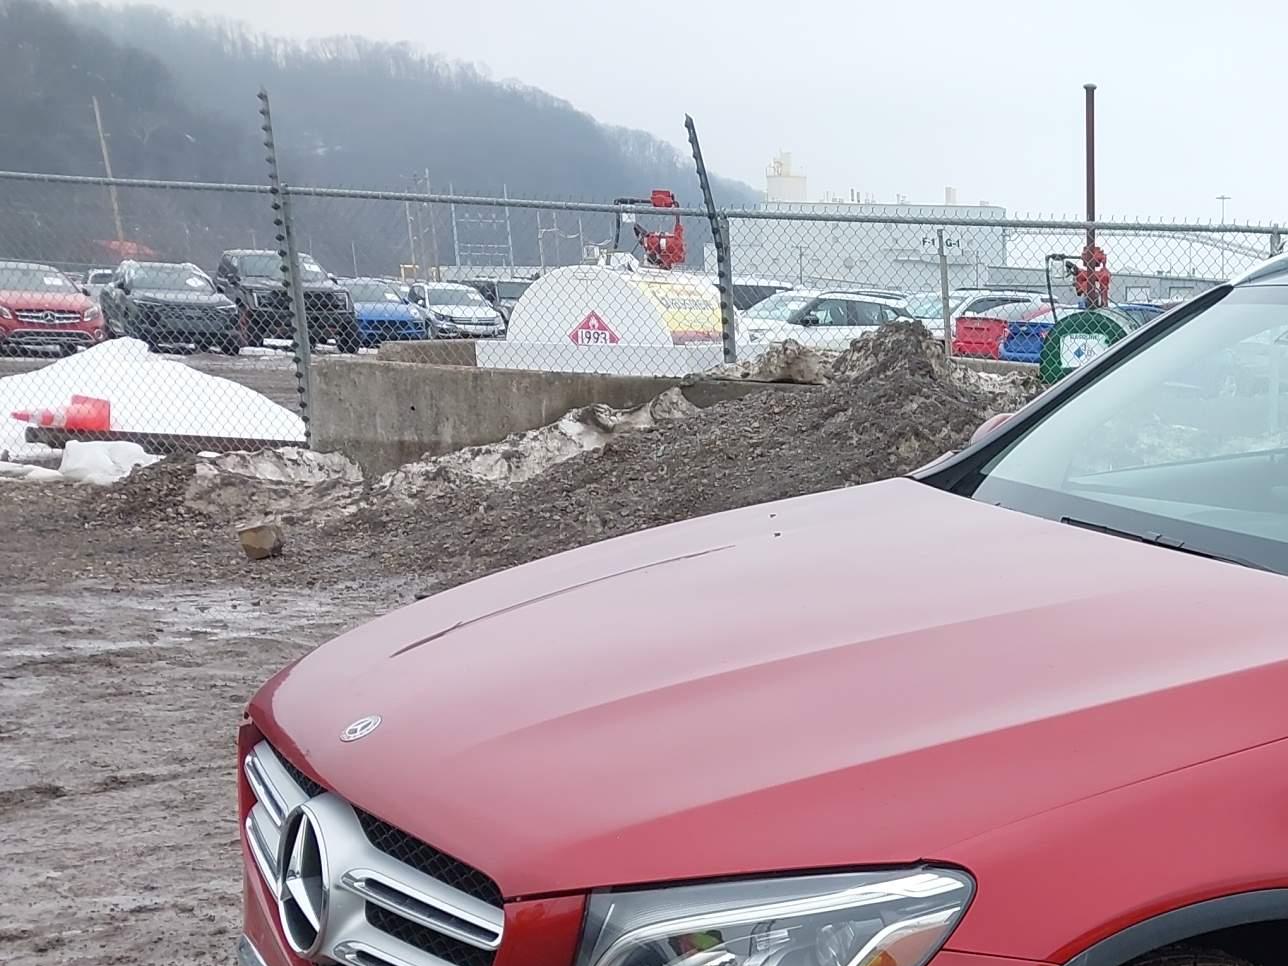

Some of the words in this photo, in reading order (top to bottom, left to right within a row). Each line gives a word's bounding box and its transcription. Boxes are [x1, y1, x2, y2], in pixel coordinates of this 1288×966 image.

[922, 237, 935, 246] F-1
[945, 238, 960, 248] G-1
[580, 330, 608, 345] 1993
